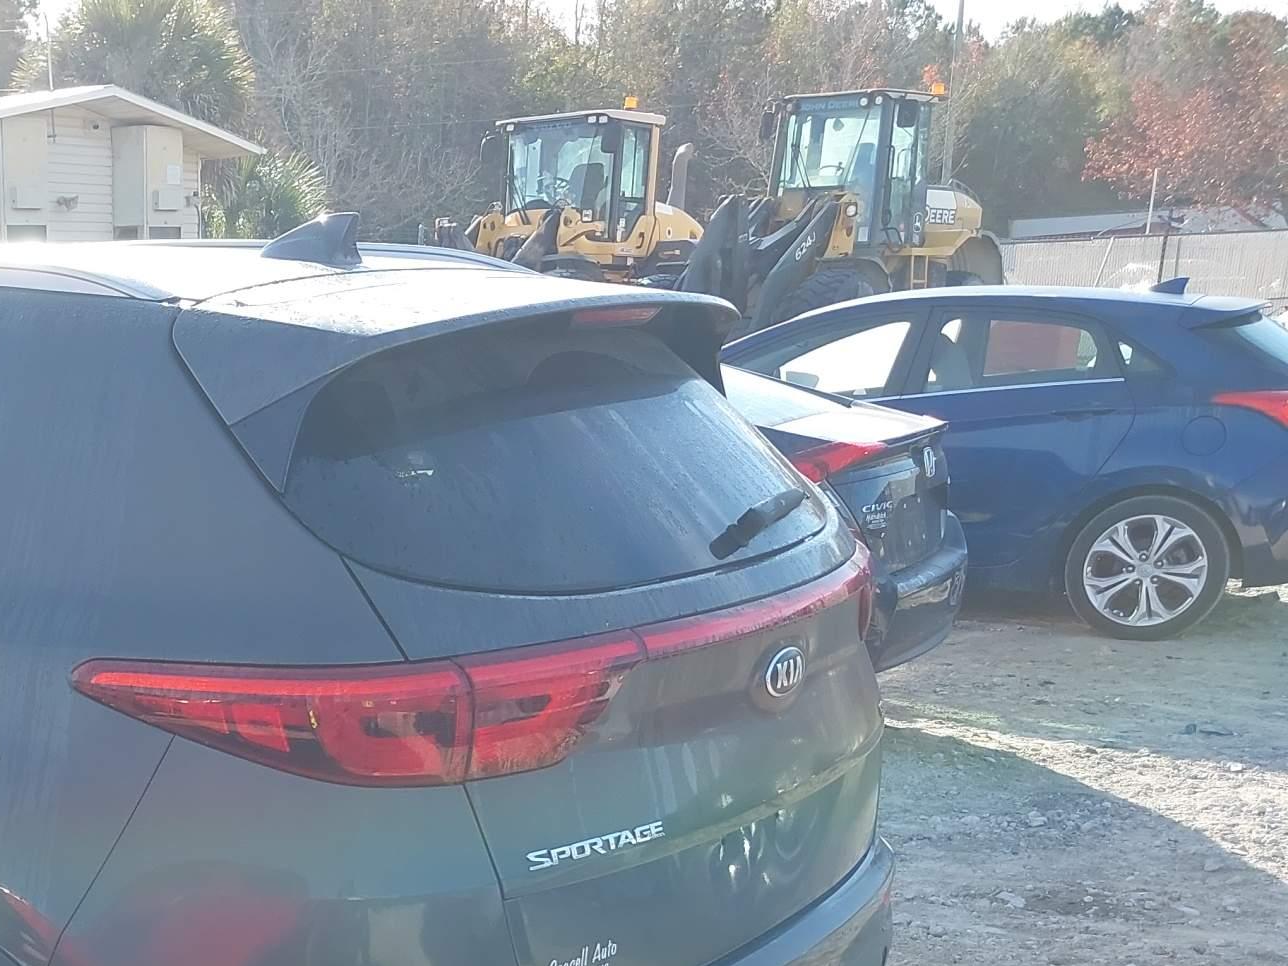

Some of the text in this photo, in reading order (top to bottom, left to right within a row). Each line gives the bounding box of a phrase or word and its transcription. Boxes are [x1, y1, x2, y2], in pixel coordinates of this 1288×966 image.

[795, 231, 816, 261] 624J
[862, 500, 893, 513] CIVIC
[776, 655, 802, 689] KIA
[526, 821, 664, 871] SPORTAGE
[592, 940, 617, 963] Auto
